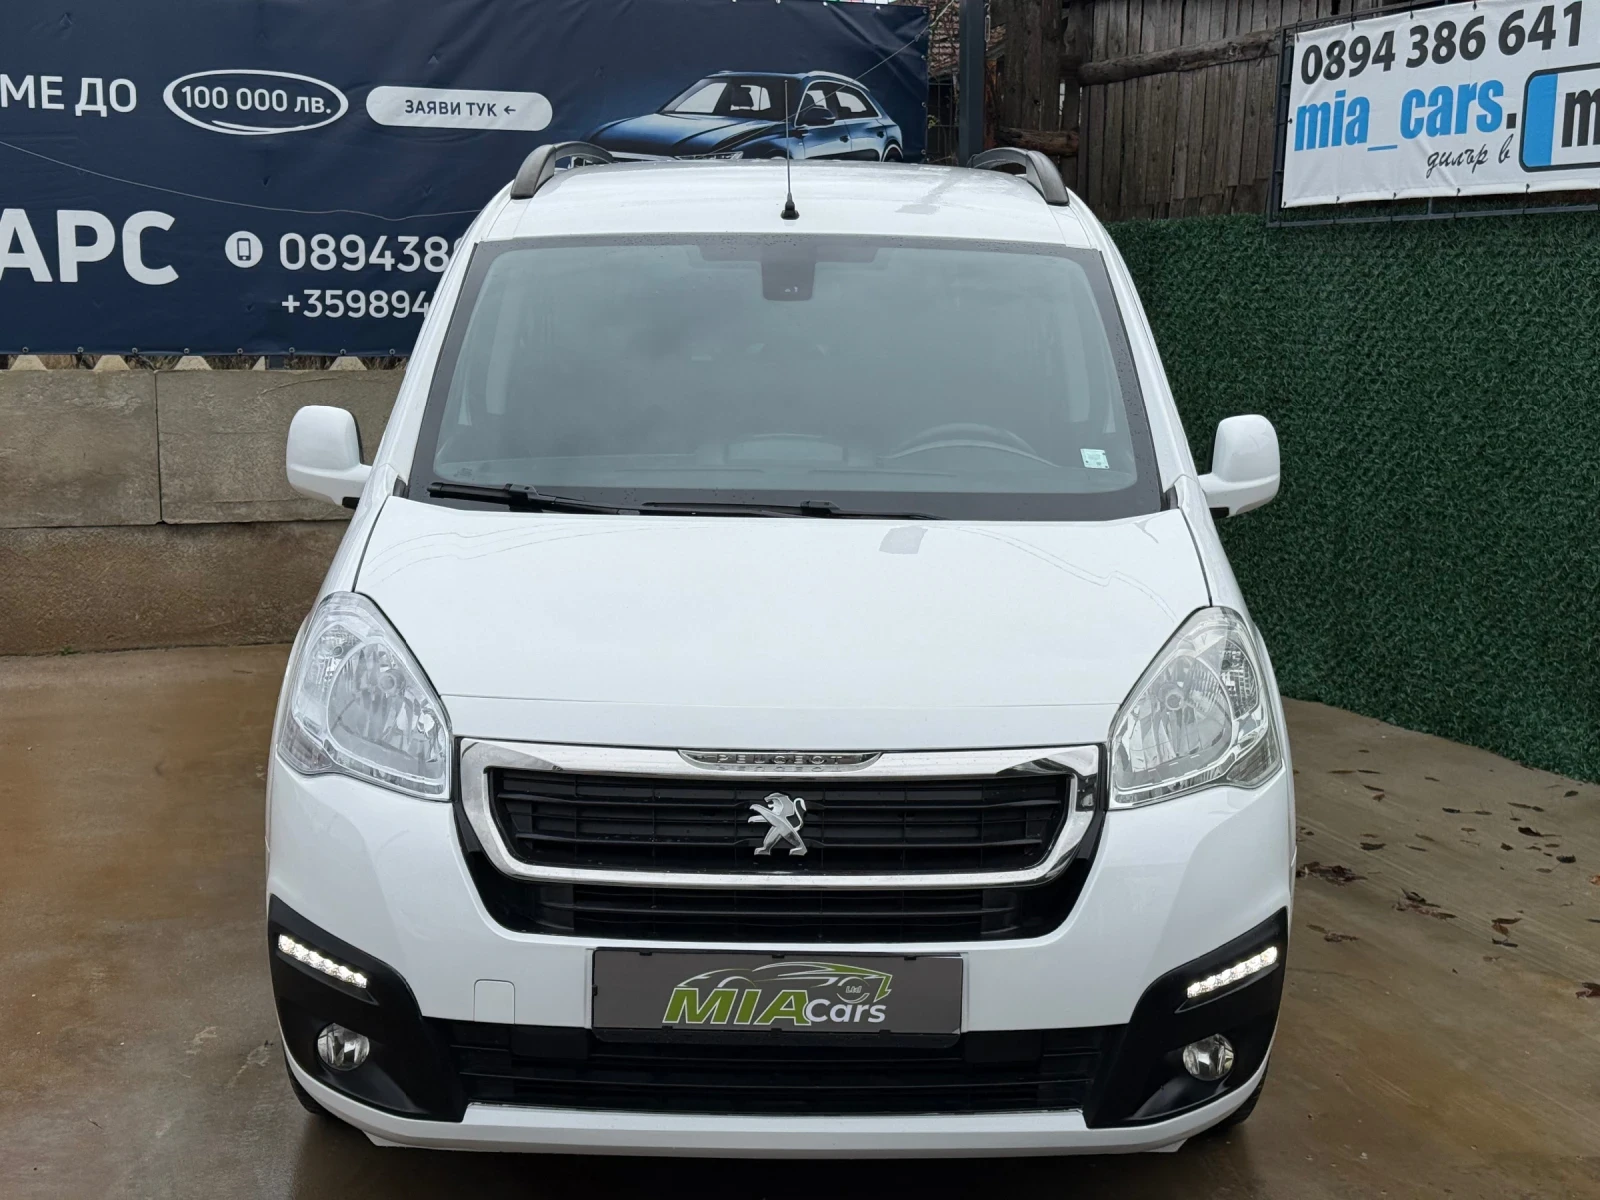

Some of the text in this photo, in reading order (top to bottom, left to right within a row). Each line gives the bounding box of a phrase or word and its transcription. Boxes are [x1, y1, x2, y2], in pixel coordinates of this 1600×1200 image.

[1301, 1, 1583, 85] 0894 386 641
[74, 78, 138, 118] ДО
[181, 85, 228, 109] 100
[235, 88, 288, 112] 000
[404, 99, 497, 118] ЗАЯВИ ТУК
[716, 753, 843, 764] PEUGEOT
[662, 987, 887, 1026] MIA Cars
